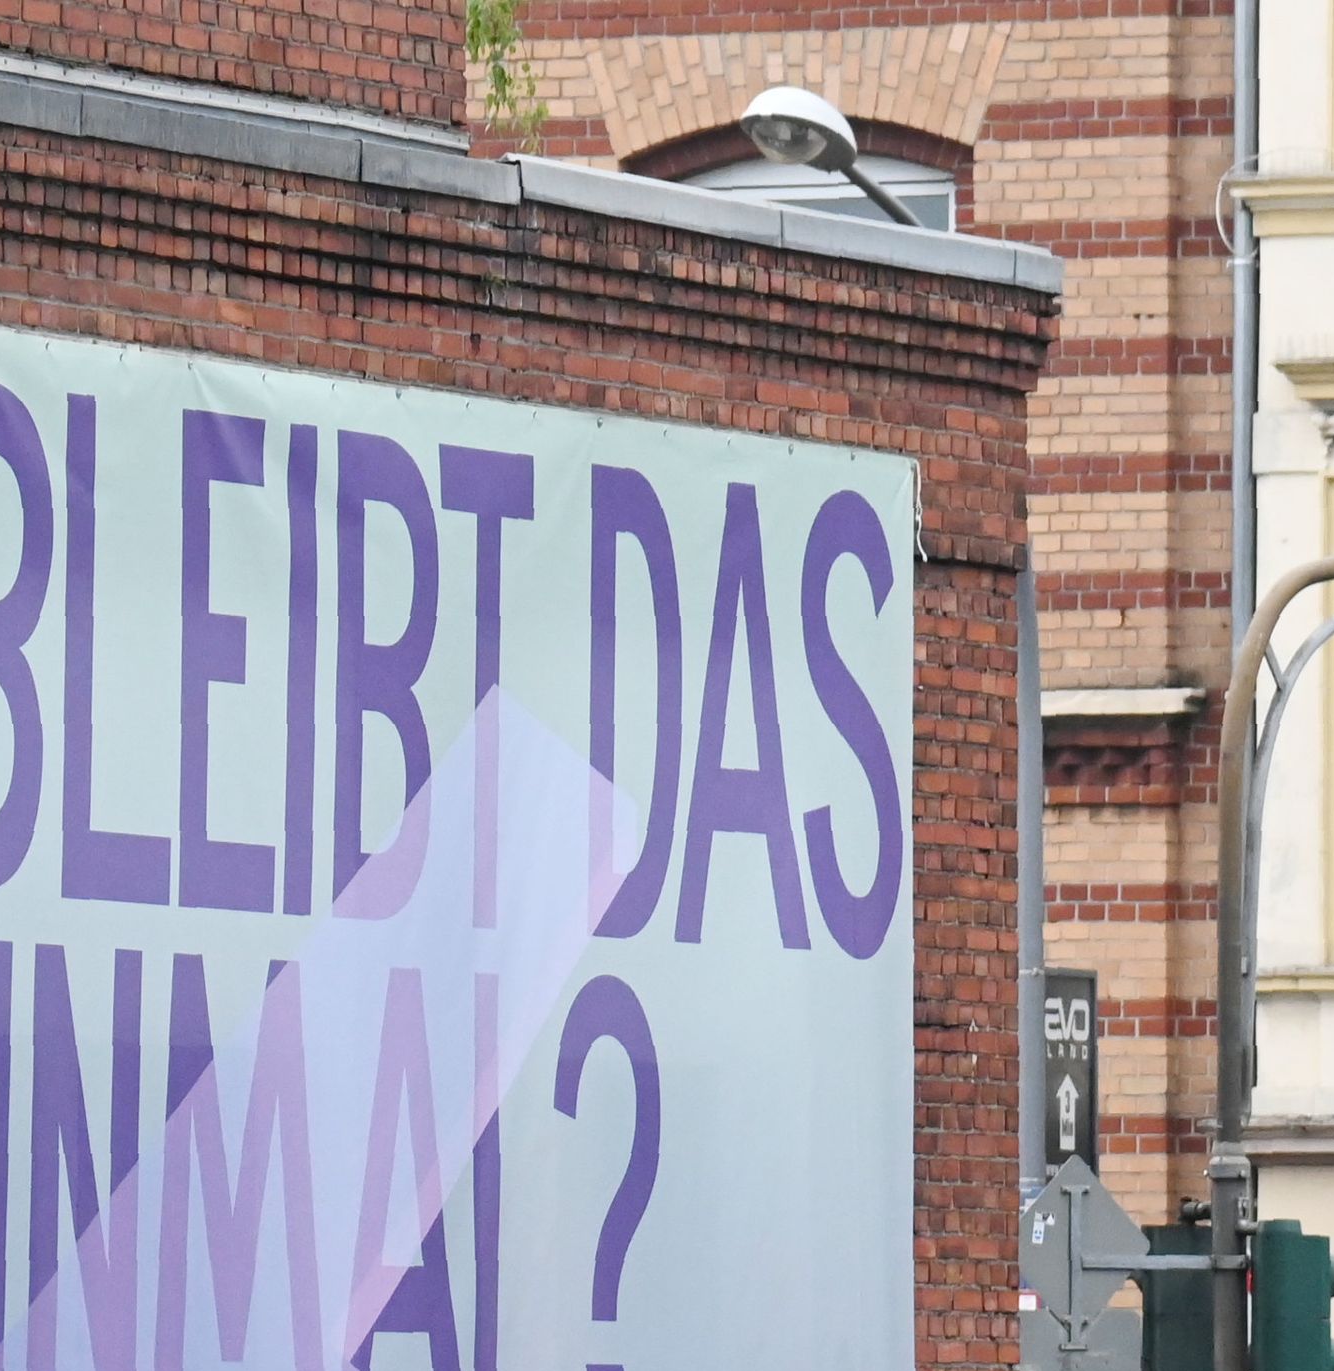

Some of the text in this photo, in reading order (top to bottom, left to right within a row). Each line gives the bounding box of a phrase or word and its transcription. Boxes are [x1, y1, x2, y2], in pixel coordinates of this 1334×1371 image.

[586, 463, 905, 961] DAS
[1044, 997, 1090, 1042] EVO
[1046, 1045, 1089, 1060] LAND
